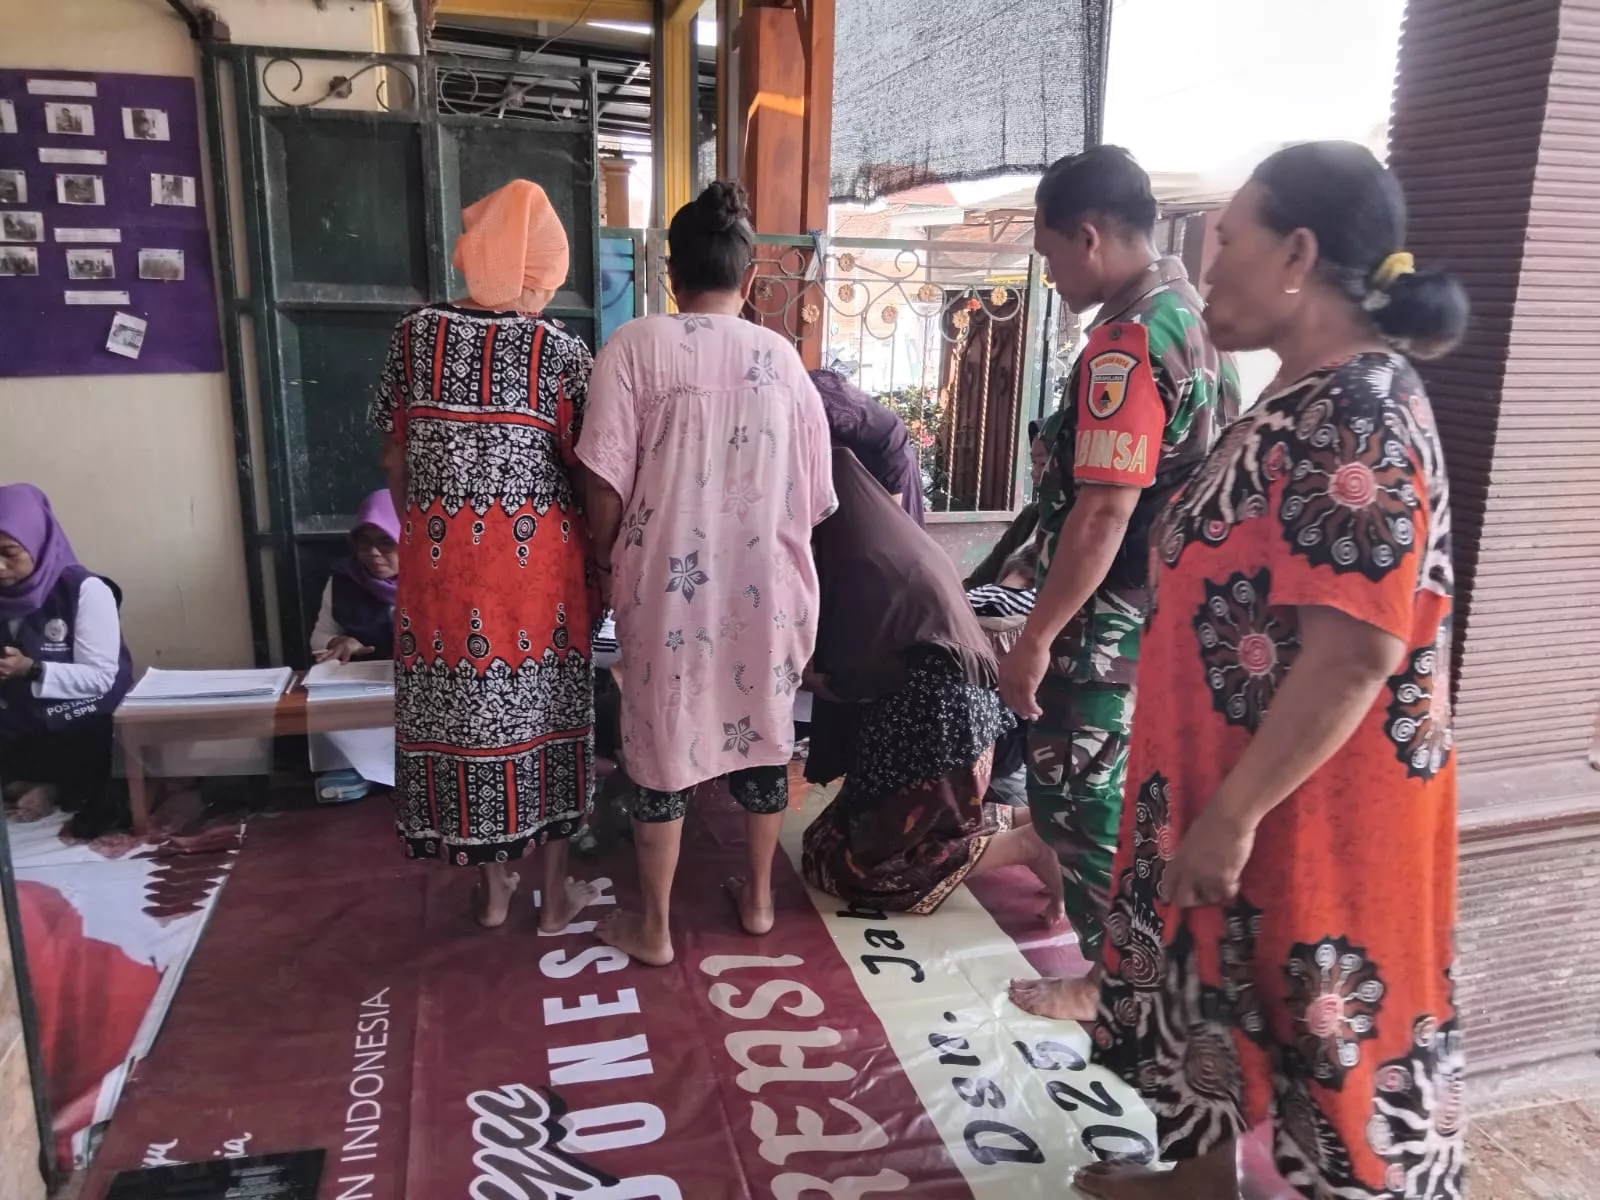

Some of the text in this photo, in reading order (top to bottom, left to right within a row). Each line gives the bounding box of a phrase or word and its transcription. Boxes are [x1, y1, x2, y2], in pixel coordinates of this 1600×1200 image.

[73, 704, 97, 717] SPM
[340, 986, 391, 1162] INDONESIA
[928, 1011, 1046, 1165] Dsn.
